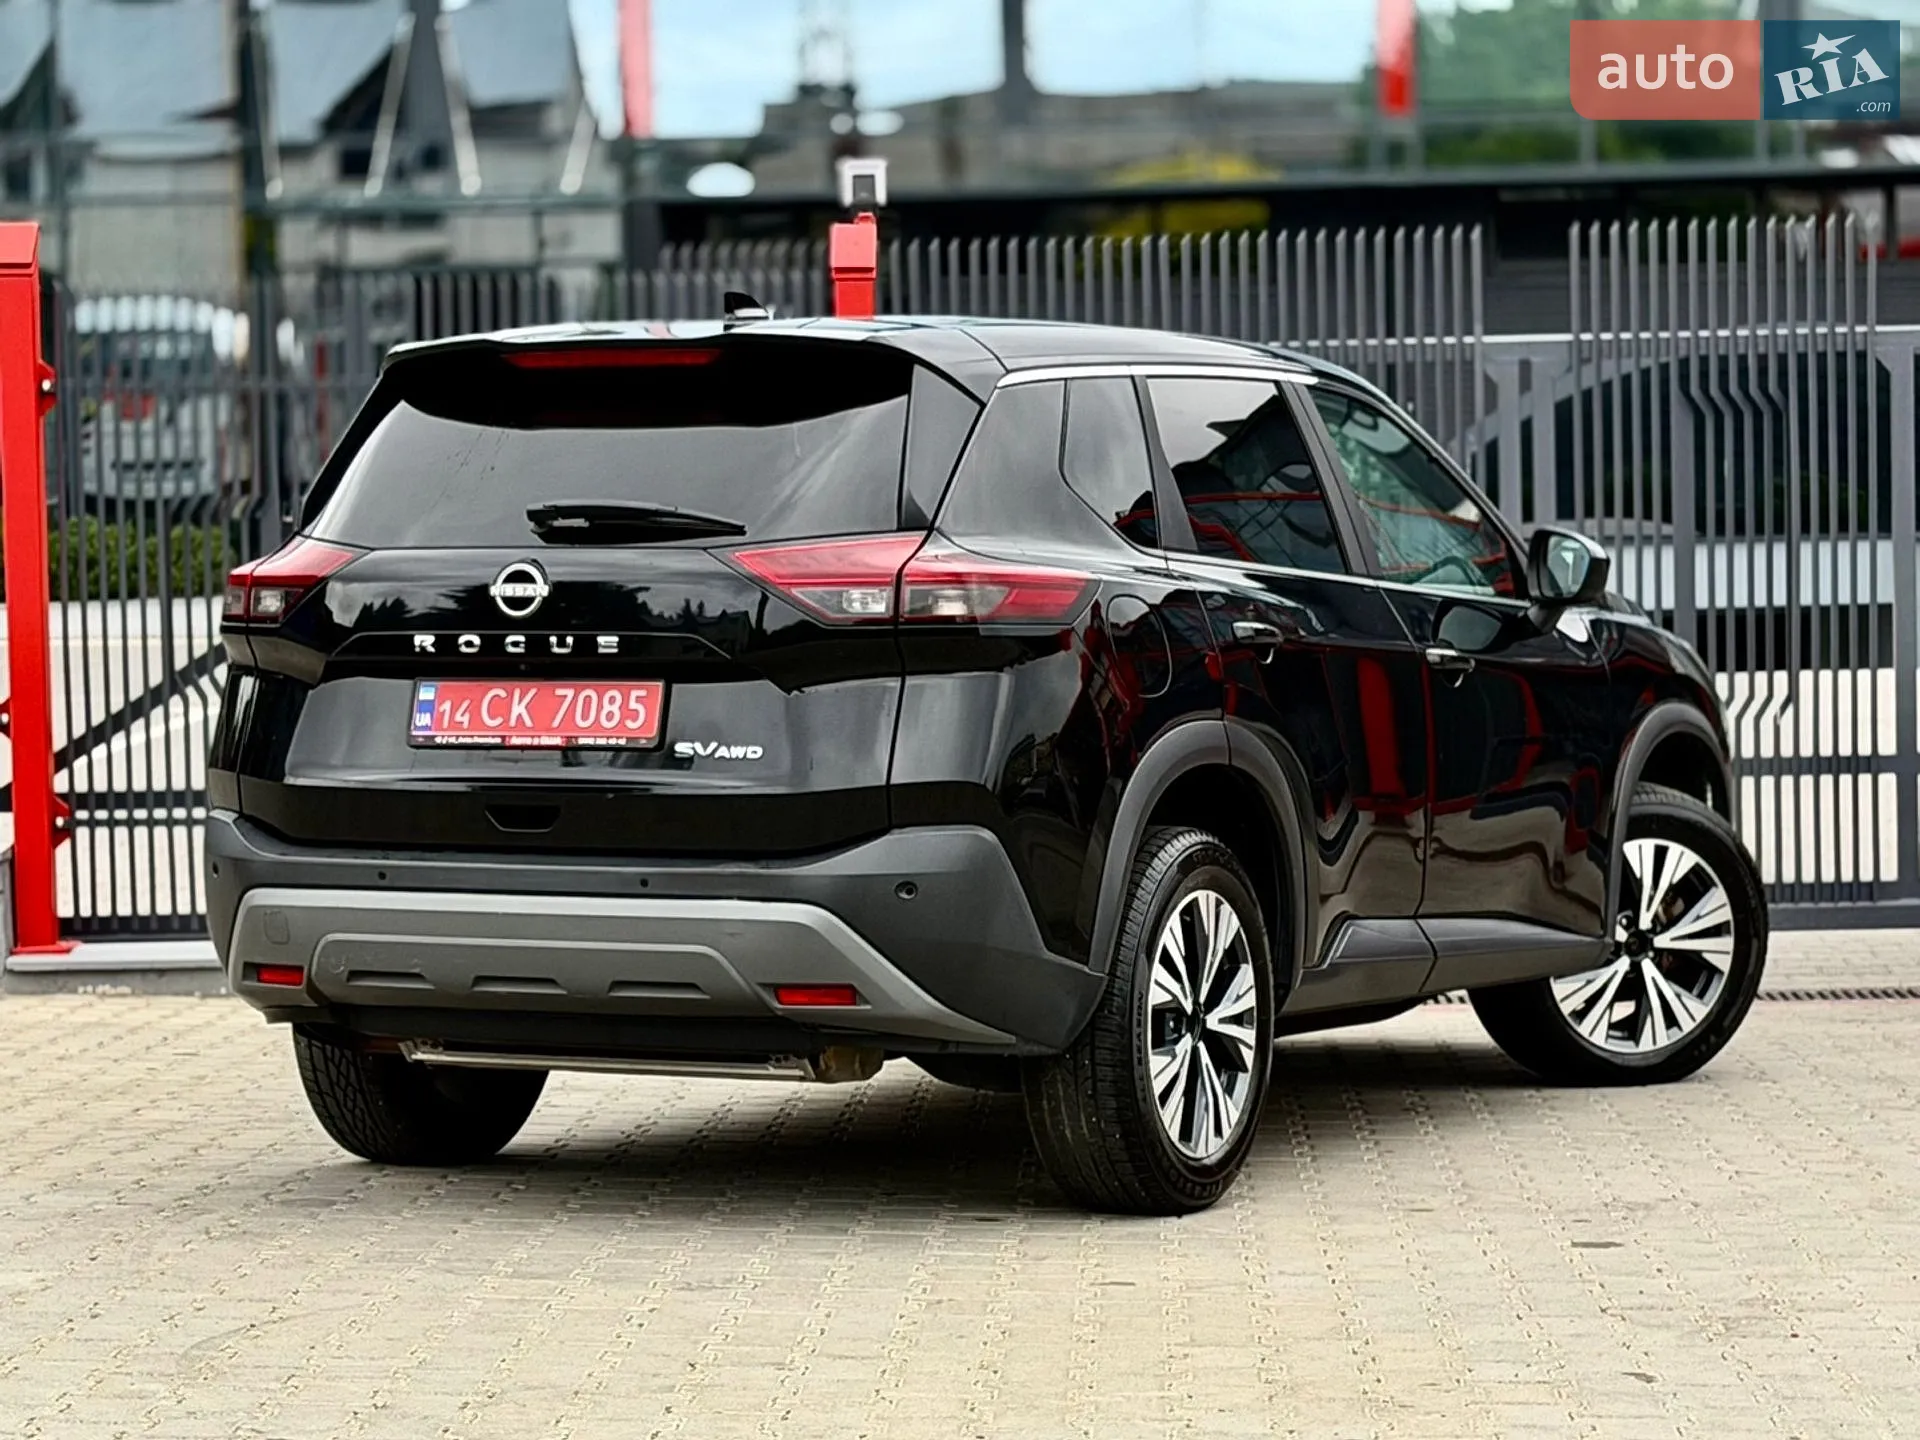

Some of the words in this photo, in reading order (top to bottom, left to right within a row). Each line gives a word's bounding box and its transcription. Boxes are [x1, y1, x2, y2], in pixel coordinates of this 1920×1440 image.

[490, 583, 550, 597] NISSAN
[413, 634, 620, 654] ROGUE
[439, 699, 471, 729] 14
[480, 687, 538, 728] CK
[551, 688, 648, 730] 7085
[415, 712, 431, 727] UA
